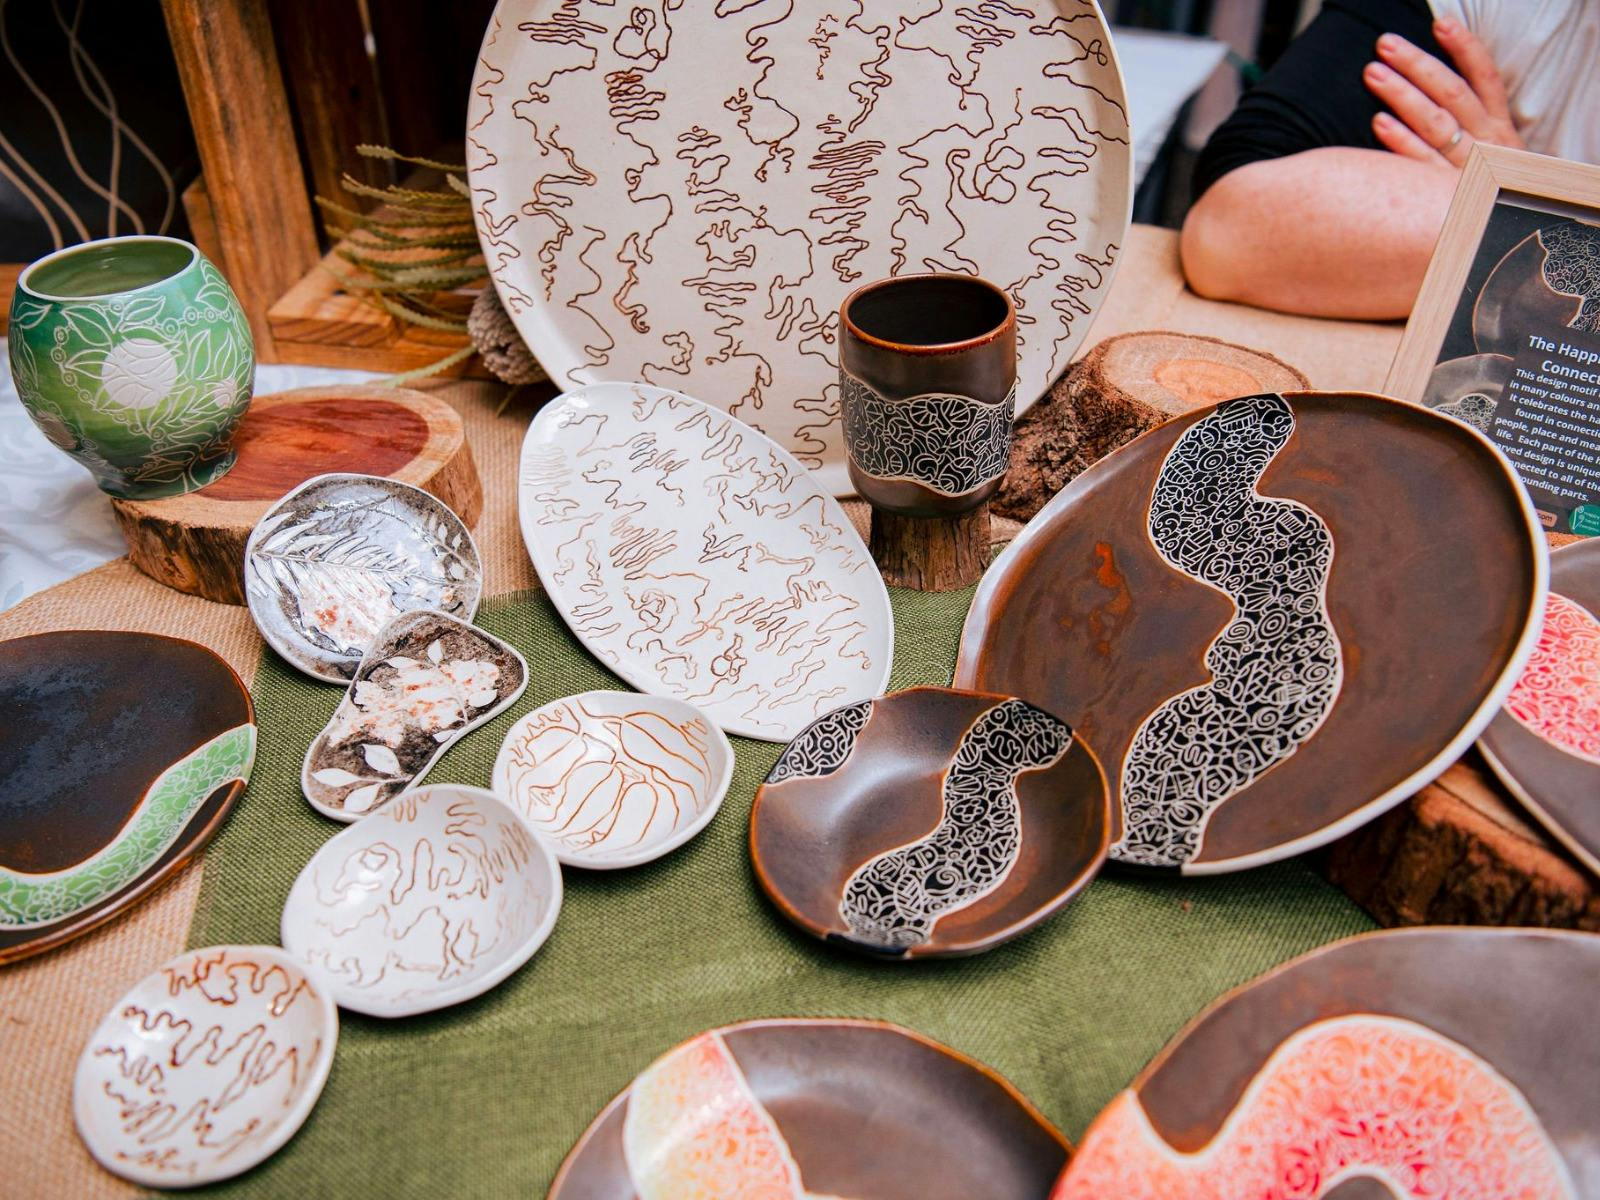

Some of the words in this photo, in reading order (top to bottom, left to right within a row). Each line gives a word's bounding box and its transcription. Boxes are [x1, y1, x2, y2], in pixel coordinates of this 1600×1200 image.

[1529, 335, 1555, 352] The
[1509, 380, 1519, 389] in
[1521, 384, 1548, 398] many
[1549, 392, 1586, 407] colours
[1516, 368, 1535, 380] This
[1536, 374, 1568, 389] design
[1569, 384, 1599, 397] motif
[1509, 393, 1518, 402] It
[1519, 397, 1569, 416] celebrates
[1570, 410, 1587, 421] the
[1515, 407, 1544, 421] found
[1544, 415, 1555, 426] in
[1494, 417, 1529, 432] people,
[1531, 426, 1557, 439] place
[1559, 434, 1579, 446] and
[1496, 428, 1513, 440] life.
[1518, 435, 1540, 448] Each
[1541, 443, 1563, 455] part
[1564, 449, 1577, 458] of
[1577, 452, 1594, 463] the
[1524, 449, 1555, 465] design
[1556, 458, 1566, 468] is
[1548, 470, 1559, 479] to
[1560, 475, 1573, 483] all
[1574, 479, 1587, 487] of
[1560, 488, 1589, 502] parts.
